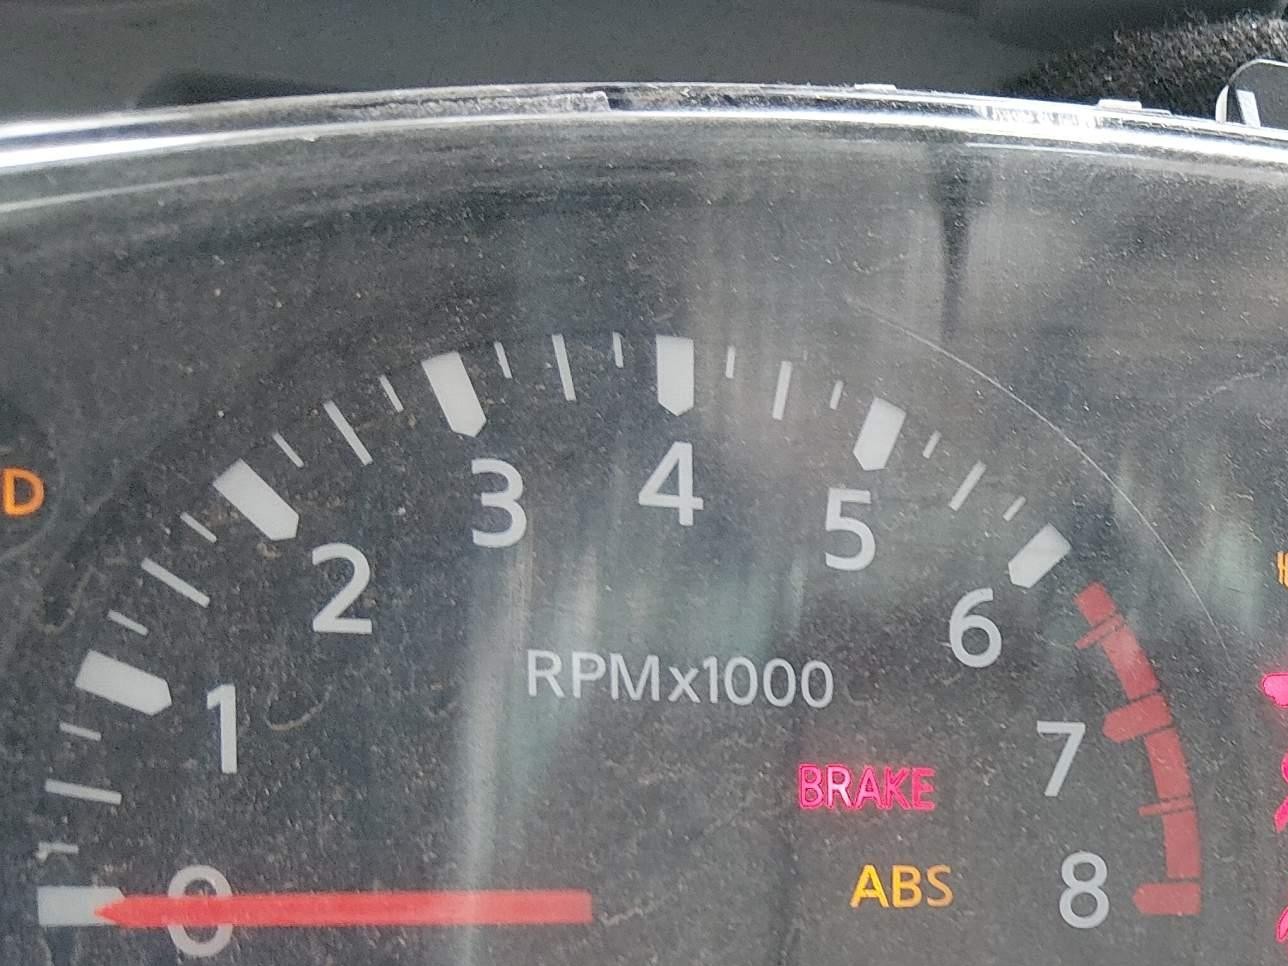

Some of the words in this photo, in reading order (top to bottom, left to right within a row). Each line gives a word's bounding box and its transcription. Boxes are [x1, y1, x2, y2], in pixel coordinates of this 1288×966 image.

[471, 458, 528, 548] 3
[638, 441, 704, 526] 4
[824, 487, 876, 571] 5
[311, 543, 373, 635] 2
[947, 587, 1002, 668] 6
[206, 684, 238, 774] 1
[1036, 720, 1086, 797] 7
[798, 764, 936, 811] BRAKE
[166, 865, 233, 958] 0
[850, 864, 955, 908] ABS
[1059, 850, 1110, 929] 8
